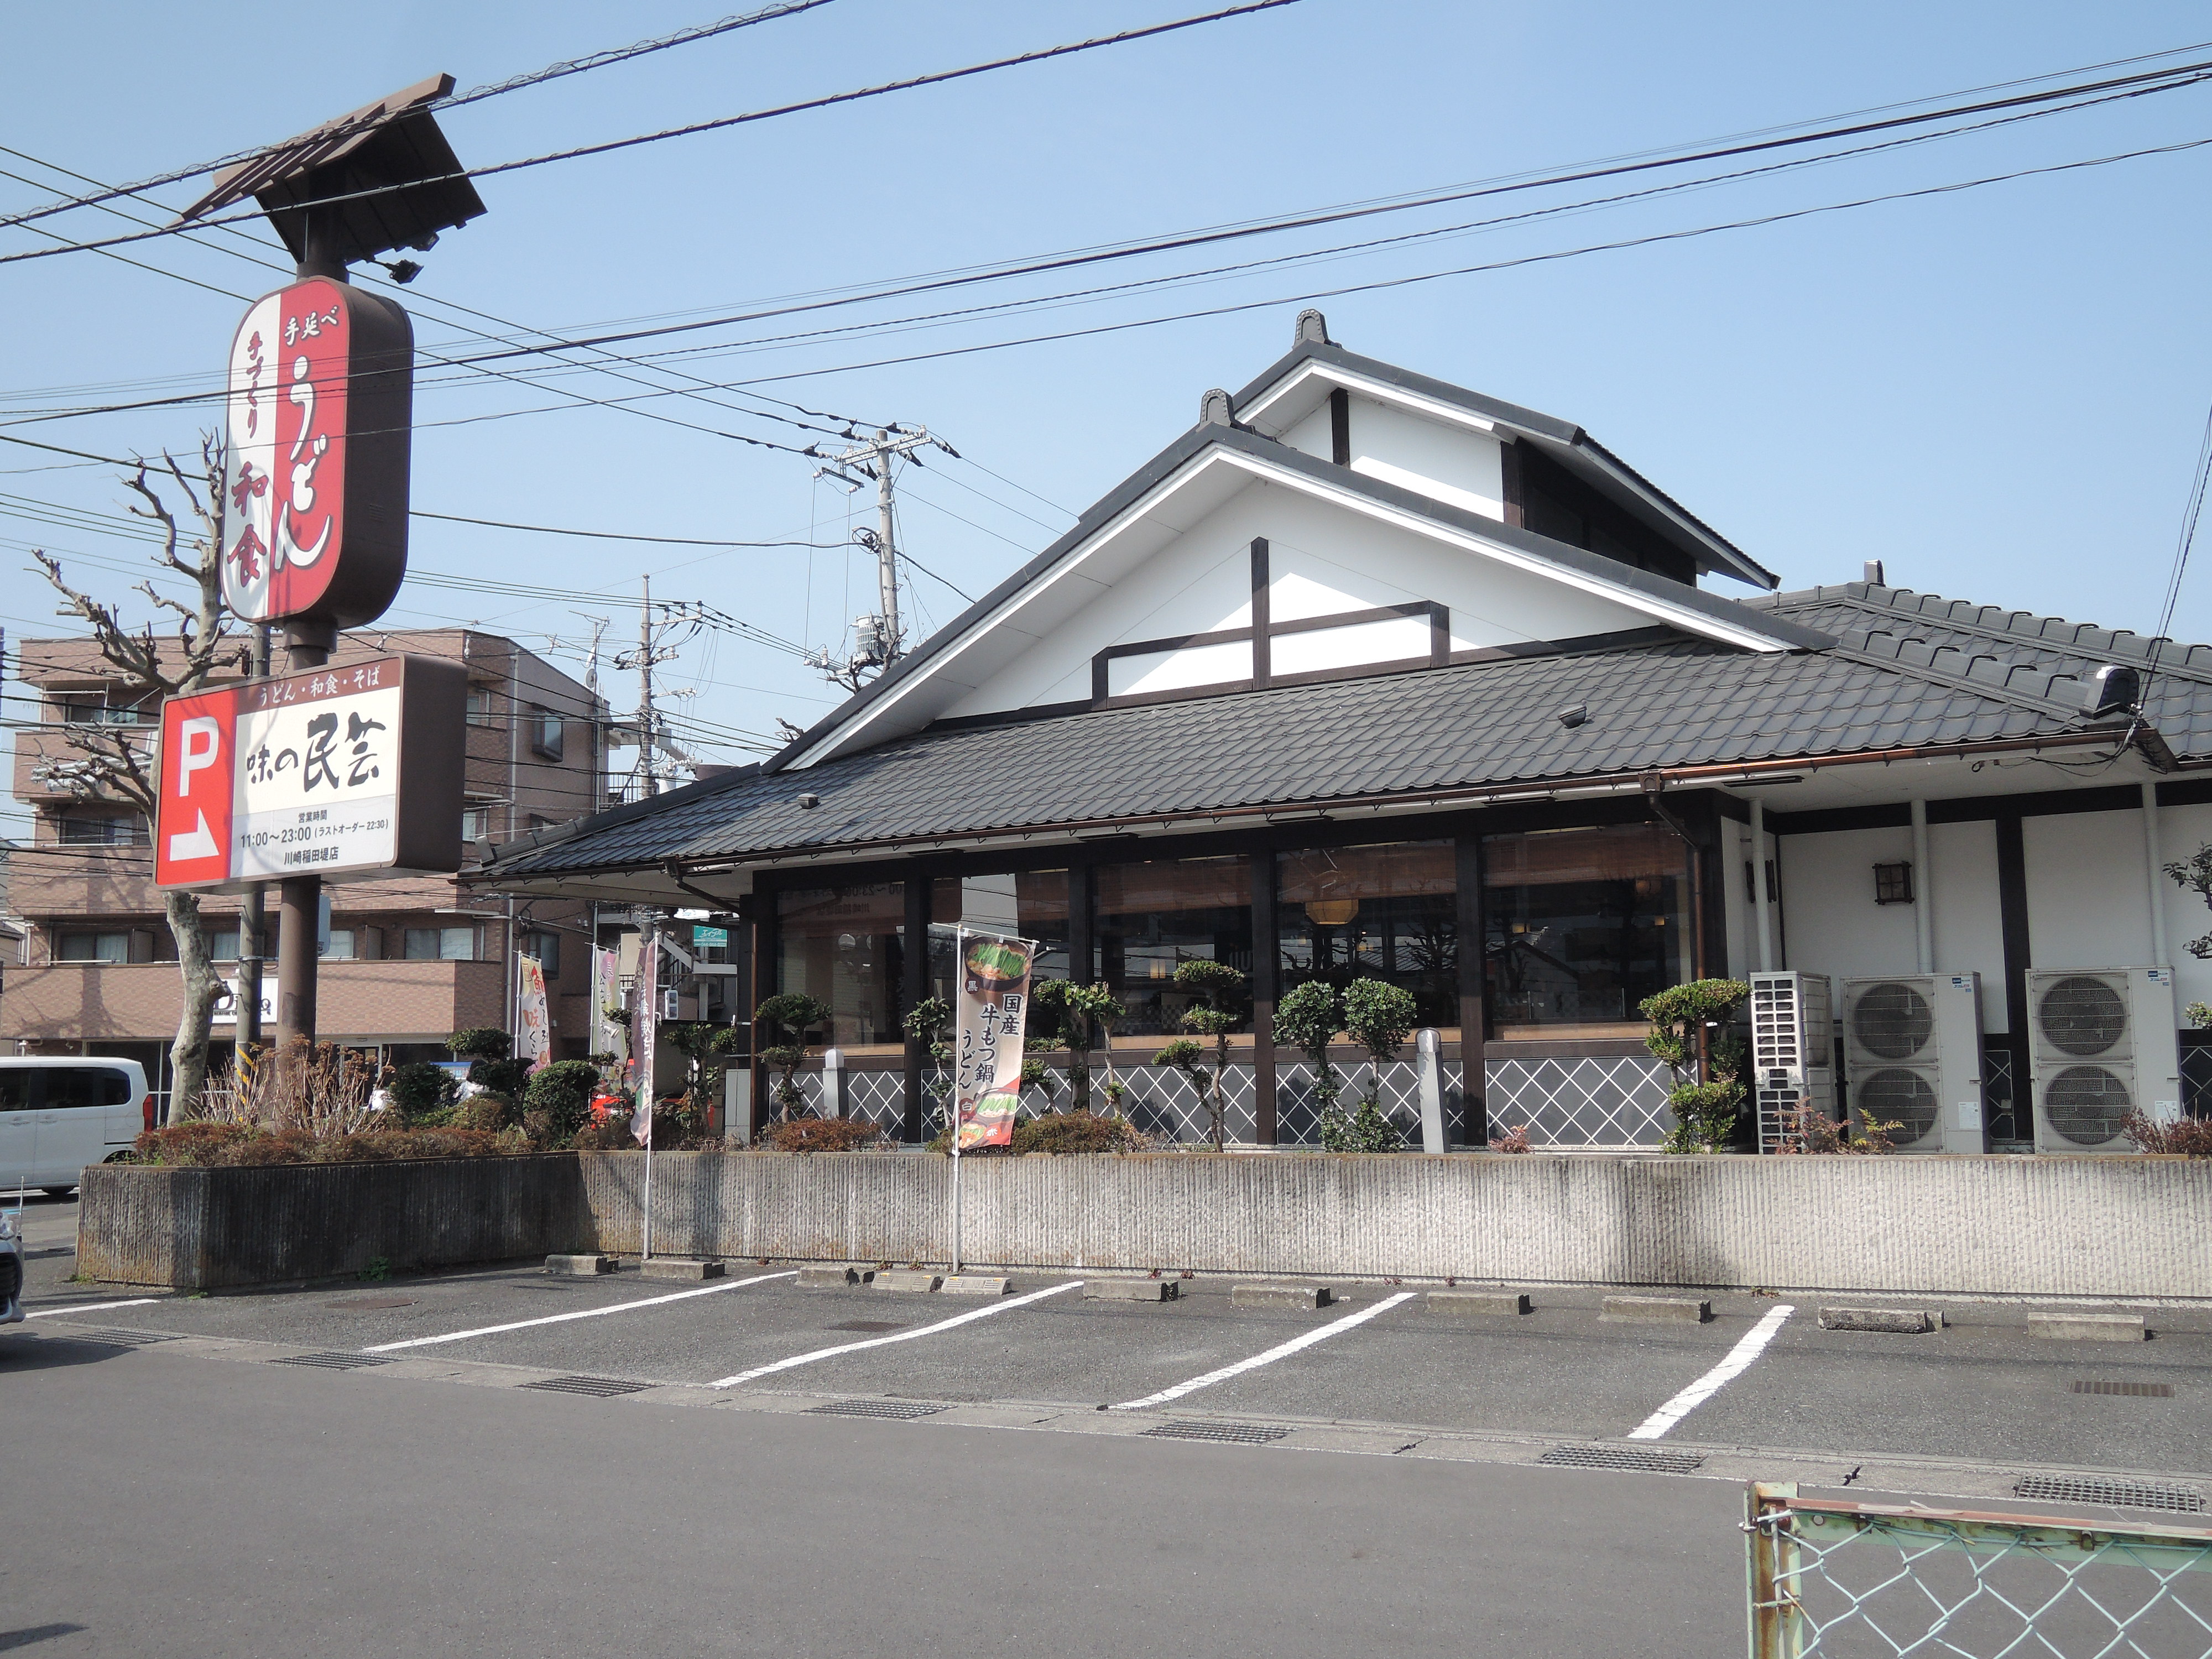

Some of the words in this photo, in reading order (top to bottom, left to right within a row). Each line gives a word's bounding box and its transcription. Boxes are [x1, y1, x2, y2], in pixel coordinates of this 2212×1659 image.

[284, 305, 338, 346] 手延べ
[246, 331, 264, 439] 手づくり
[275, 355, 331, 570] うどん
[227, 461, 269, 587] 和食
[179, 716, 220, 797] P
[247, 712, 387, 792] 味の民芸
[298, 809, 327, 823] 営業時間
[284, 847, 339, 865] 川崎稲田堤店
[967, 980, 978, 992] 黒
[999, 994, 1023, 1035] 国産
[958, 1029, 975, 1089] うどん
[974, 1004, 1001, 1083] 牛もつ鍋
[962, 1101, 973, 1111] 白
